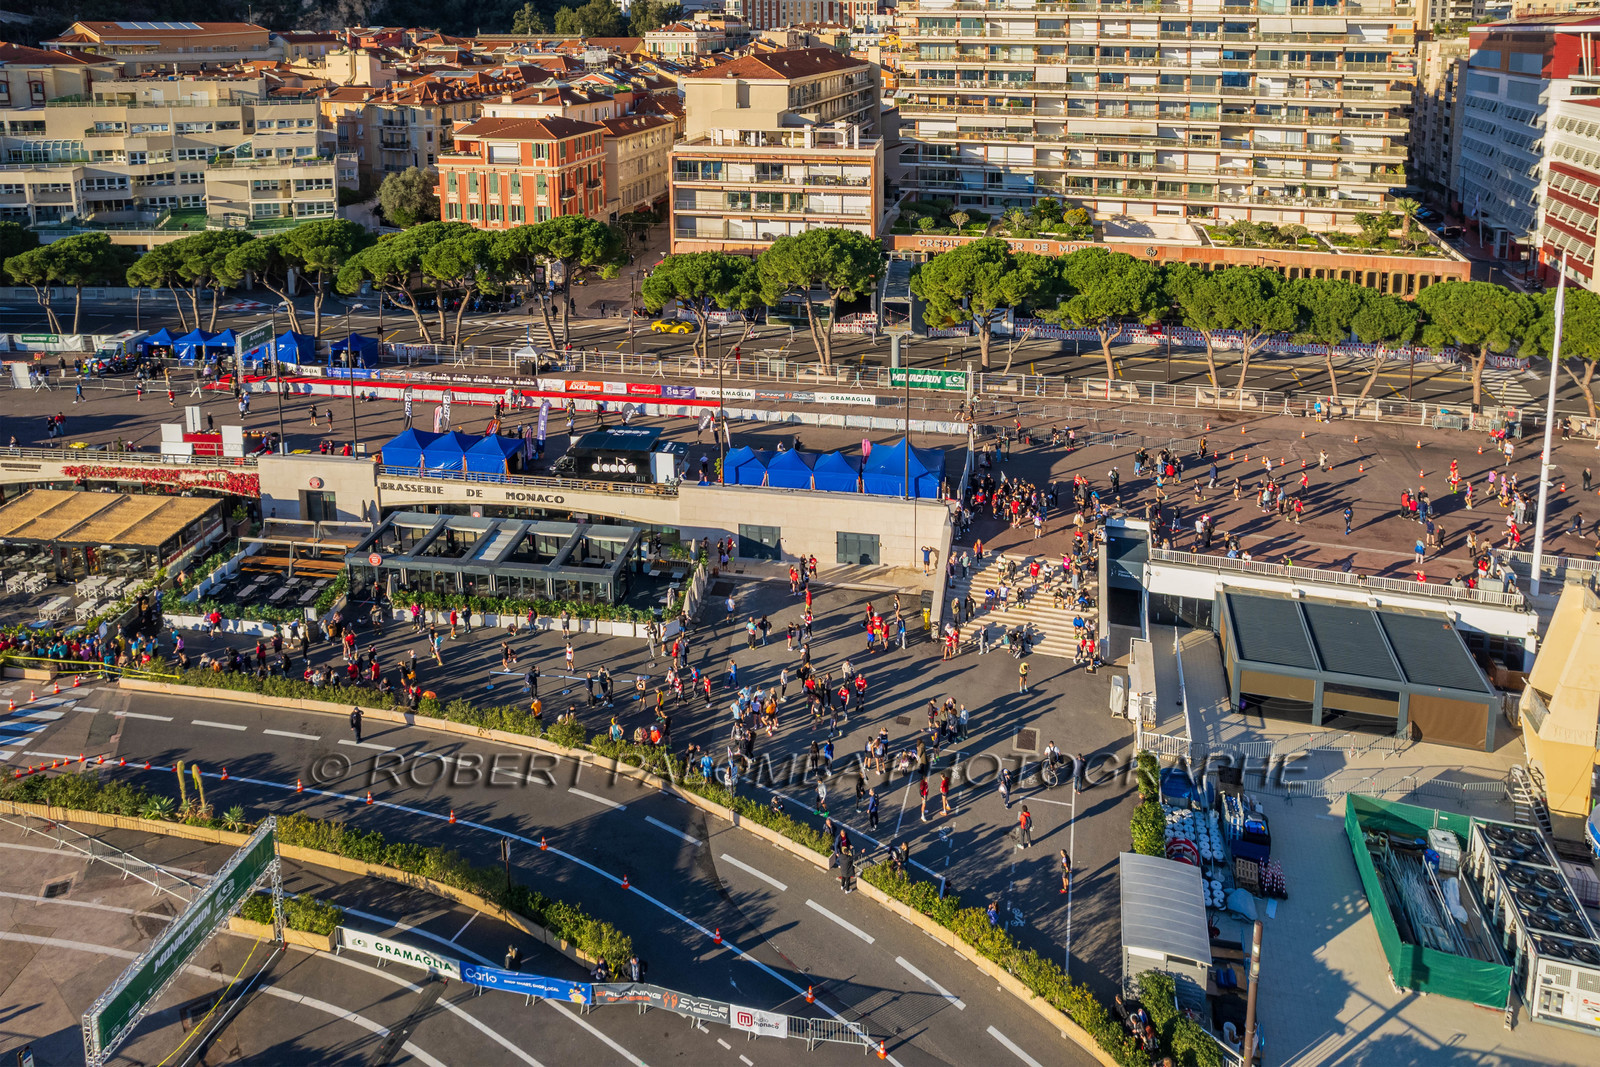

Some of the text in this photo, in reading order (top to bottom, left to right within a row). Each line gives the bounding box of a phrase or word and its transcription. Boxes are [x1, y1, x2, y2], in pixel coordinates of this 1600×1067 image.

[918, 239, 961, 248] CREDIT
[1033, 243, 1049, 252] DE
[1058, 244, 1112, 253] MONO
[592, 456, 636, 474] diadora
[380, 482, 564, 504] BRASSERIE DE MONACO
[374, 942, 452, 972] GRAMAGLIA
[466, 968, 497, 983] Carlo
[678, 1004, 727, 1020] PASSION
[680, 998, 728, 1013] CYCLE
